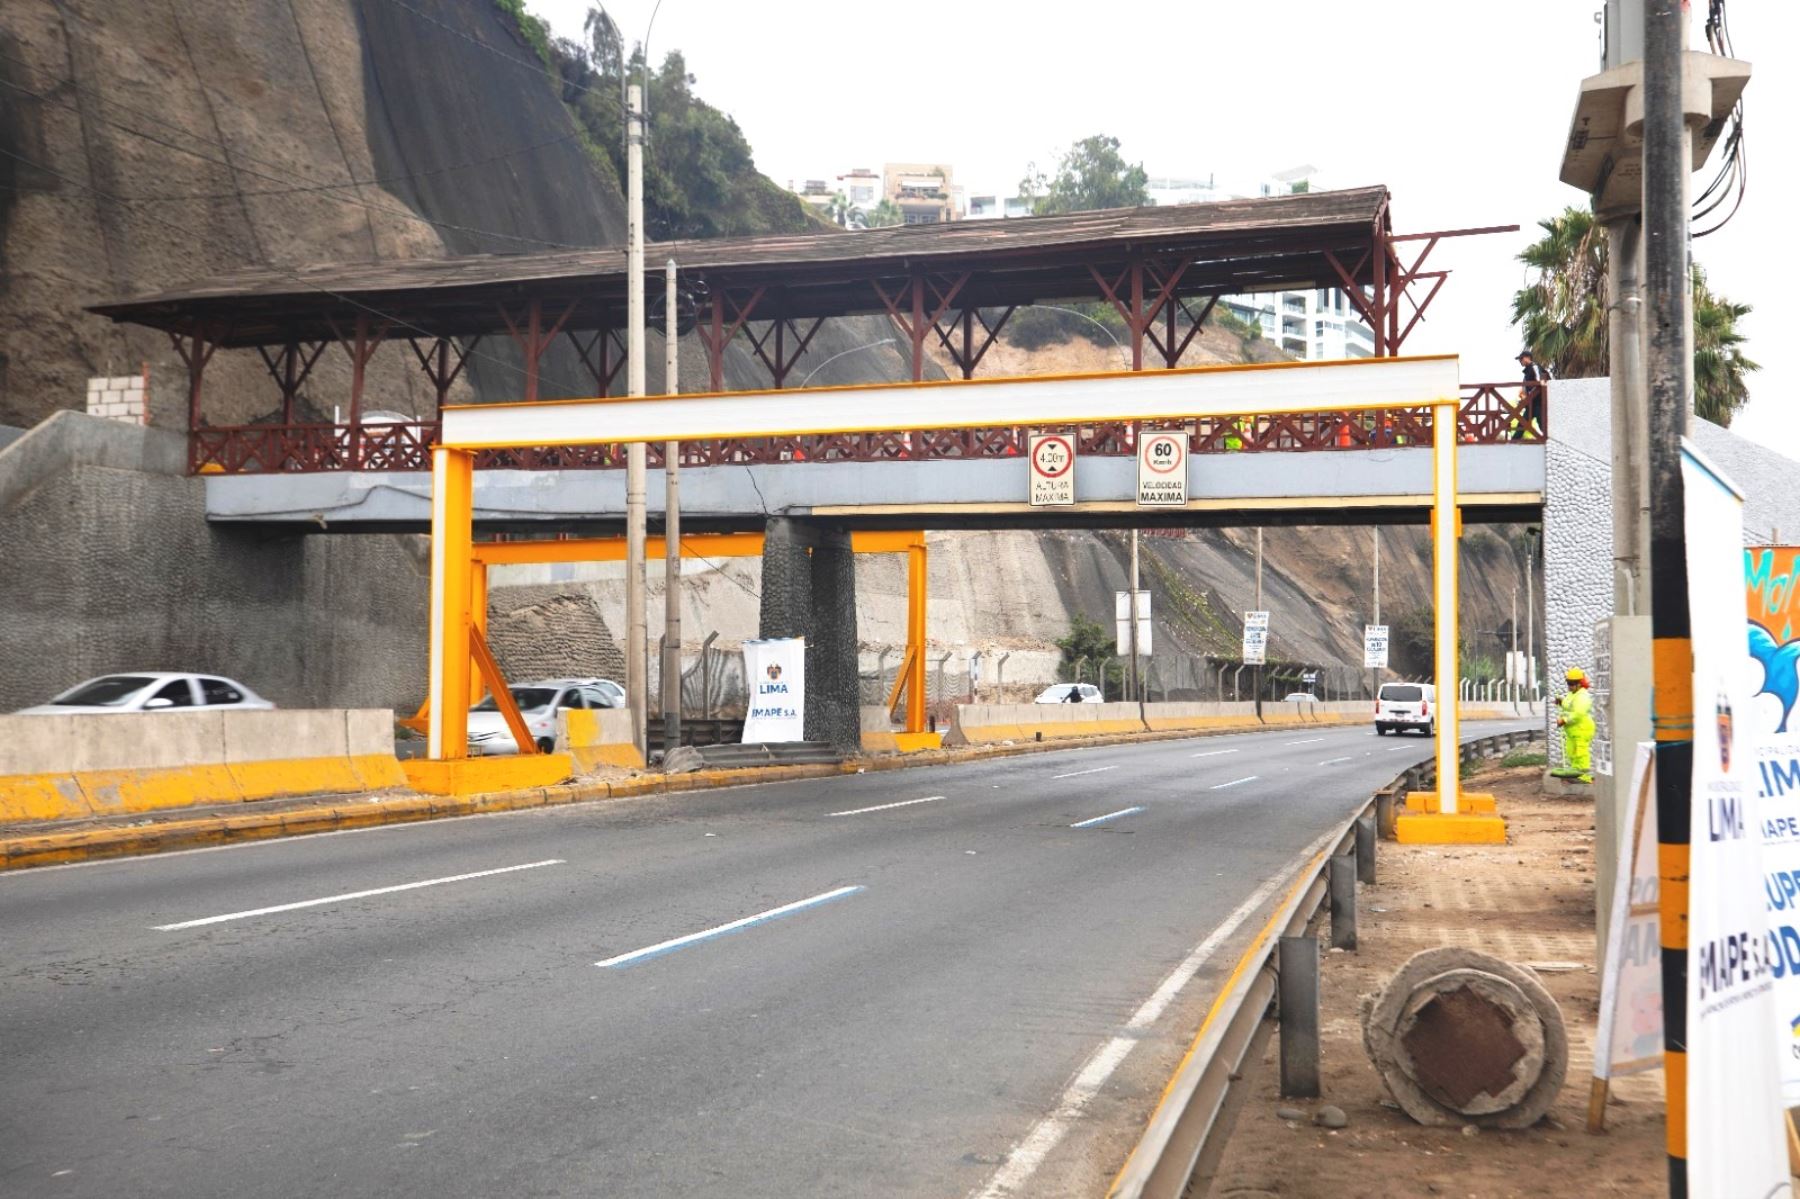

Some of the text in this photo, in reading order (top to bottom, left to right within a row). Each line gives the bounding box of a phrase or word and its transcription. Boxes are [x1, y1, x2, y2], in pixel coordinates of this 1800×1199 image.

[1154, 442, 1172, 457] 60
[1142, 481, 1182, 490] VELOCIDAD
[1035, 492, 1069, 502] MAXIMA
[1141, 492, 1183, 502] MAXIMA
[759, 684, 789, 694] LIMA
